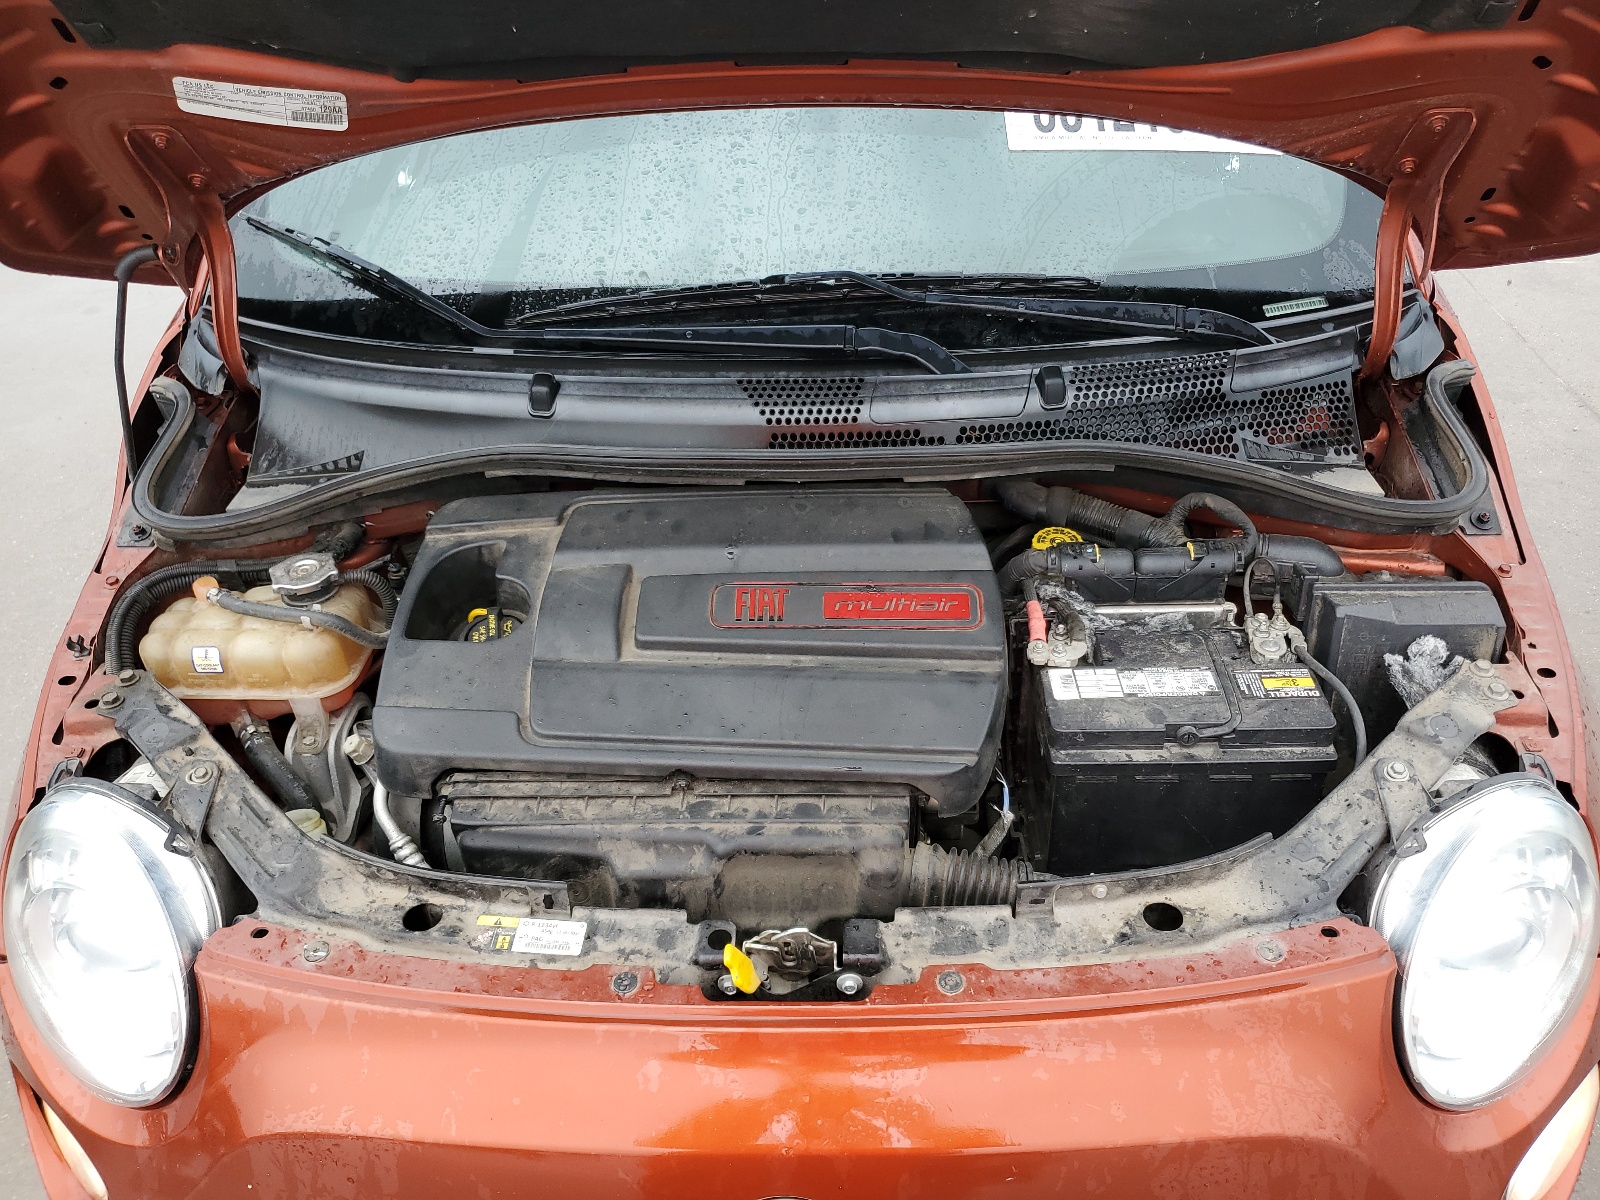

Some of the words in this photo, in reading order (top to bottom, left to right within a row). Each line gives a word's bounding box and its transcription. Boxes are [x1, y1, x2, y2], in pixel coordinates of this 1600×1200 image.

[257, 88, 282, 97] EMISSION
[283, 91, 306, 99] CONTROL
[307, 93, 342, 101] INFORMATION
[735, 588, 790, 622] FIAT
[833, 597, 959, 612] multiair
[1291, 678, 1299, 687] 3
[1267, 690, 1321, 698] DURACELL
